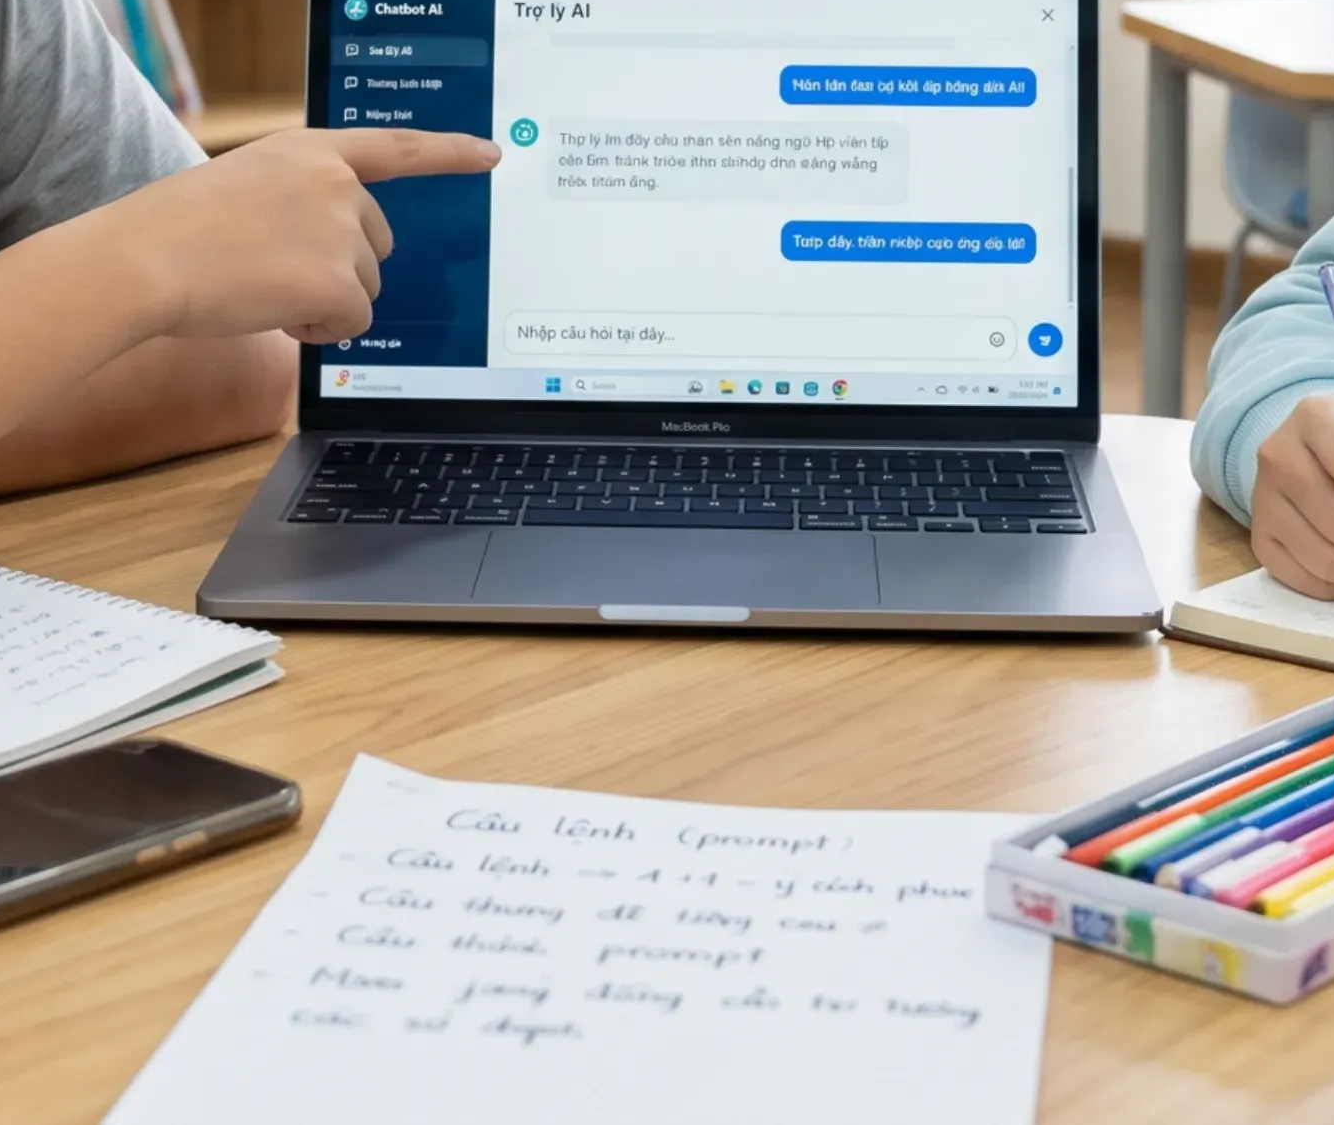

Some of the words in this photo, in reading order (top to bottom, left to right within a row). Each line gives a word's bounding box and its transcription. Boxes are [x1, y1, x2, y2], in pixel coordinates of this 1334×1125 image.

[374, 2, 426, 16] Chatbot
[514, 2, 545, 22] Trợ
[571, 3, 590, 19] AI
[661, 421, 711, 432] MacBook
[446, 809, 522, 834] Câu
[554, 817, 636, 845] lệnh
[597, 944, 765, 970] prompt
